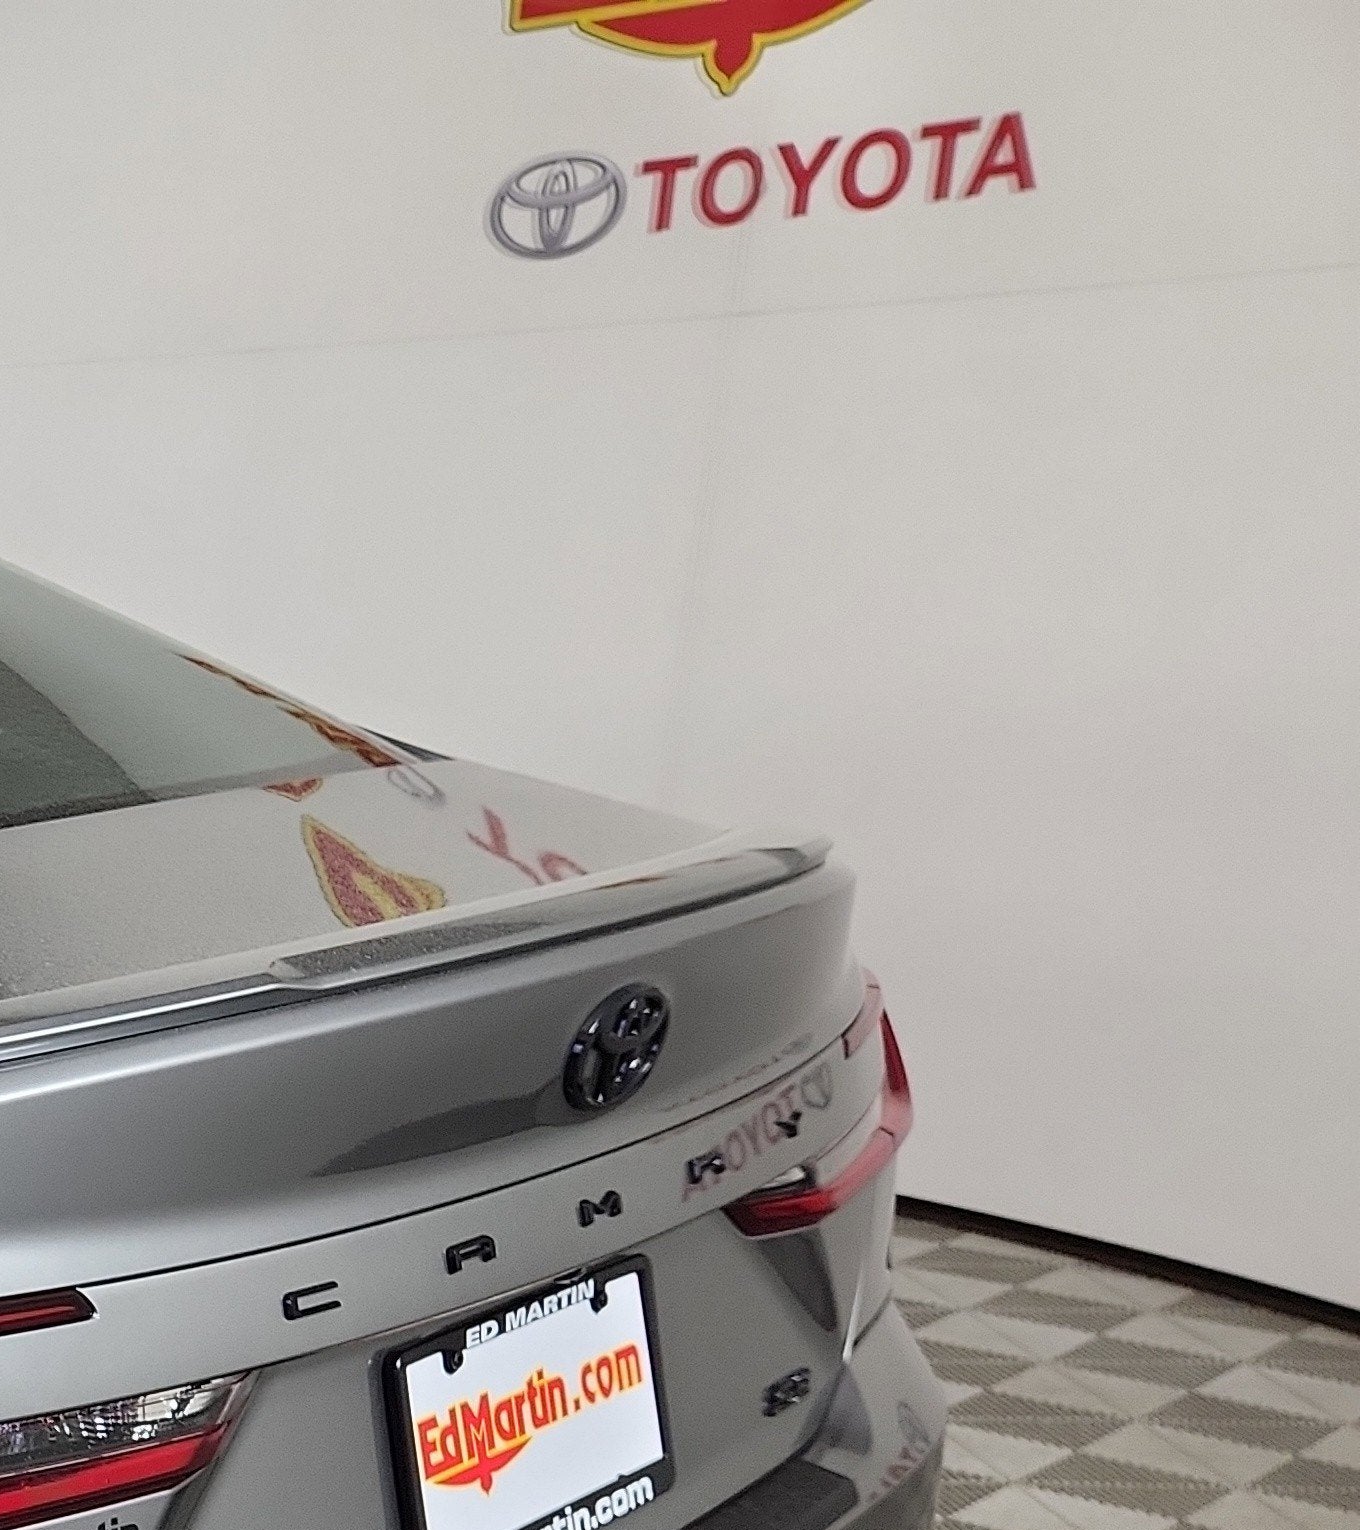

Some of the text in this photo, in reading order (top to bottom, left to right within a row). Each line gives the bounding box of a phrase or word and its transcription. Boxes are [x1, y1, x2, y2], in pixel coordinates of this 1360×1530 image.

[639, 111, 1036, 233] TOYOTA
[282, 1110, 803, 1321] CAMRY
[466, 1278, 595, 1350] ED MARTIN
